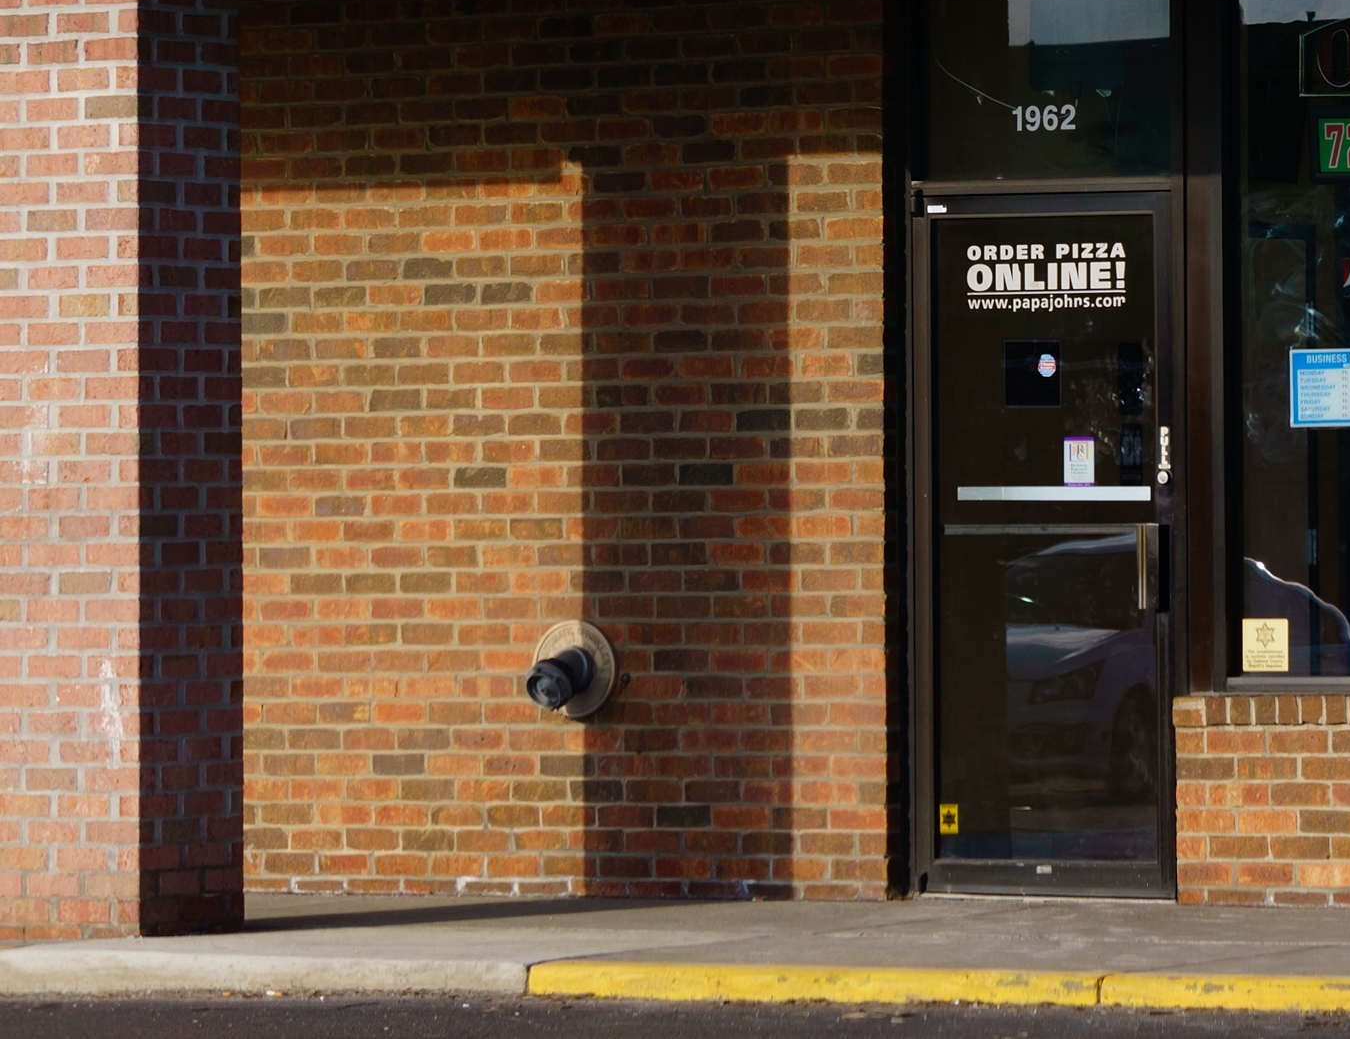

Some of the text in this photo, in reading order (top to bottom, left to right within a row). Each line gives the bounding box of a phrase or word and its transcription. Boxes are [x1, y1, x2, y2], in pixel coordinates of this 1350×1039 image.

[1012, 104, 1076, 132] 1962
[966, 242, 1126, 261] ORDER PIZZA
[966, 261, 1126, 292] ONLINE!
[967, 294, 1127, 312] www.papajohns.com
[1306, 353, 1348, 364] BUSINESS
[1159, 425, 1170, 465] PULL
